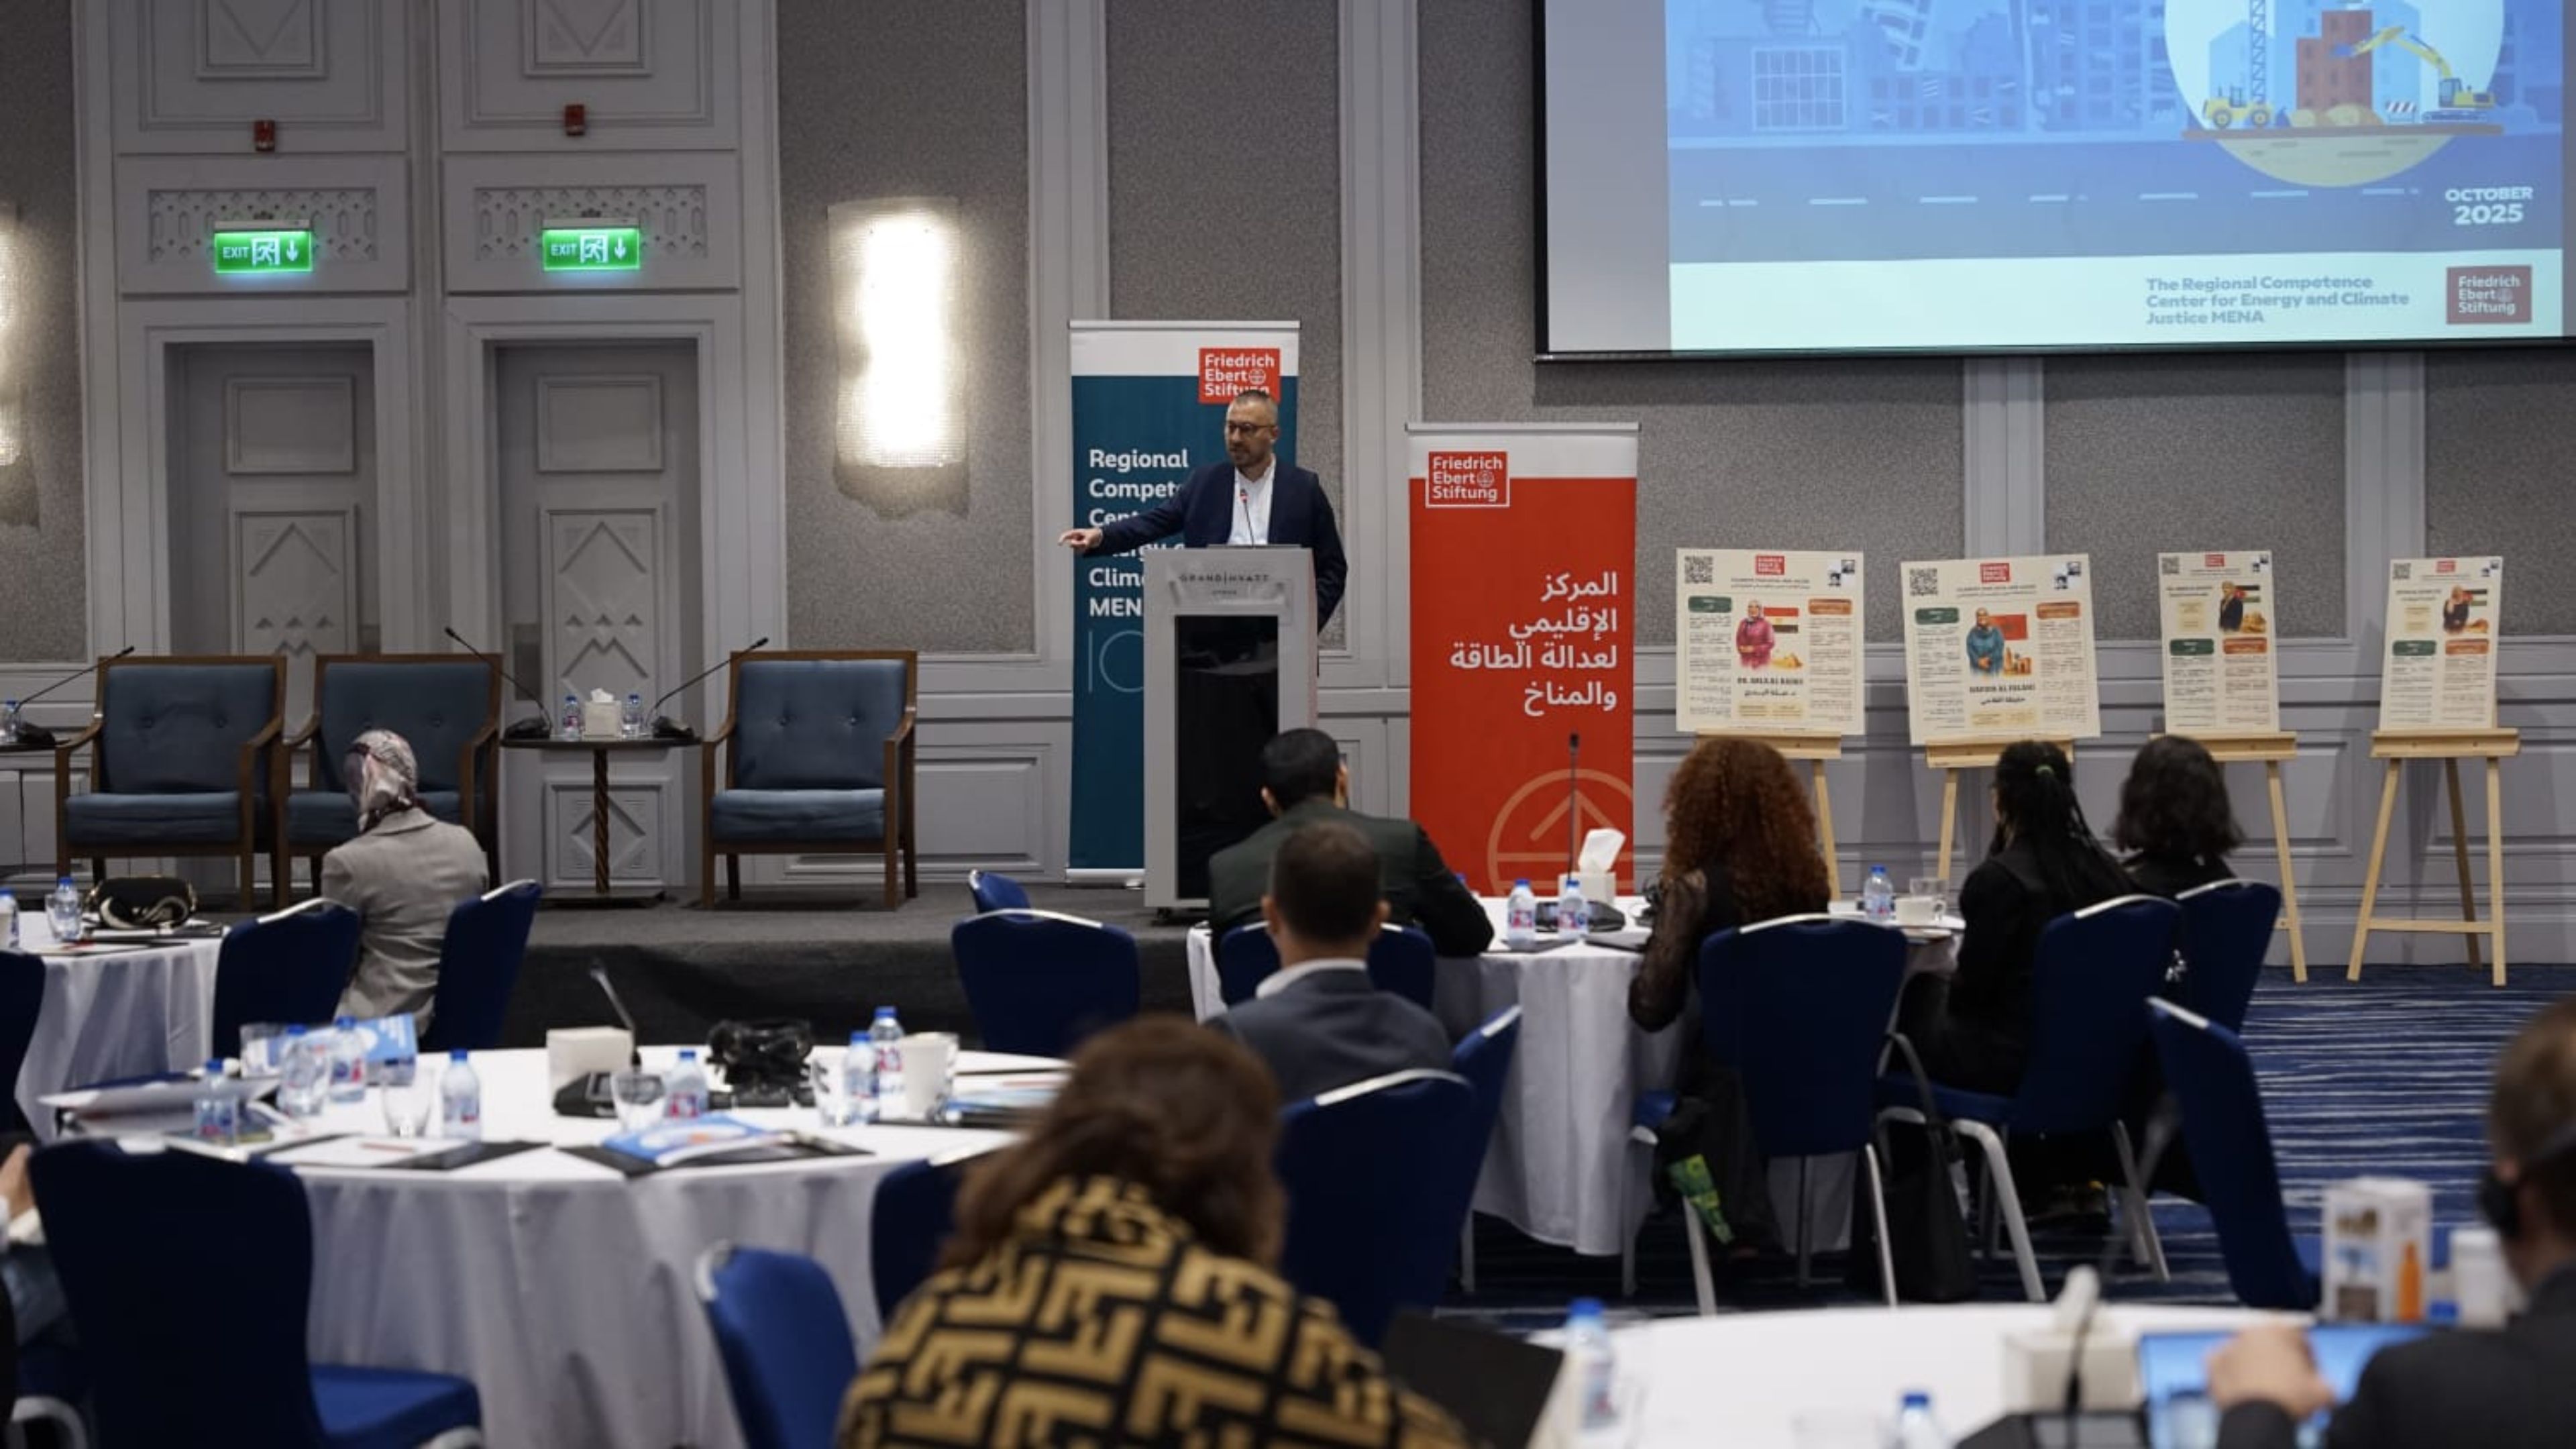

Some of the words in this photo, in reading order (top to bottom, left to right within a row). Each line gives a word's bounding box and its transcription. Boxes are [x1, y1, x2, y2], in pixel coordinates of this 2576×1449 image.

[2445, 186, 2534, 201] OCTOBER
[2455, 203, 2524, 225] 2025
[222, 246, 249, 258] EXIT
[550, 244, 577, 256] EXIT
[2147, 278, 2179, 290] The
[2182, 276, 2257, 292] Regional
[2260, 276, 2373, 290] Competence
[2458, 275, 2520, 287] Friedrich
[2146, 294, 2207, 308] Center
[2211, 293, 2237, 307] for
[2241, 292, 2302, 309] Energy
[2306, 292, 2338, 305] and
[2341, 291, 2410, 305] Climate
[2458, 288, 2496, 301] Ebert
[2458, 302, 2516, 316] Stiftung
[2146, 311, 2208, 325] Justice
[2211, 310, 2265, 323] MENA
[1205, 353, 1275, 368] Friedrich
[1205, 368, 1248, 382] Ebert
[1089, 448, 1189, 472] Regional
[1433, 456, 1503, 470] Friedrich
[1433, 470, 1475, 484] Ebert
[1433, 486, 1498, 502] Stiftung
[1089, 568, 1144, 587] Clim
[1540, 571, 1617, 602] المركز
[1089, 597, 1143, 616] MEN
[1509, 606, 1617, 645] الإقليمي
[1450, 641, 1532, 669] الطاقة
[1541, 641, 1617, 669] لعدالة
[1523, 680, 1617, 716] والمناخ
